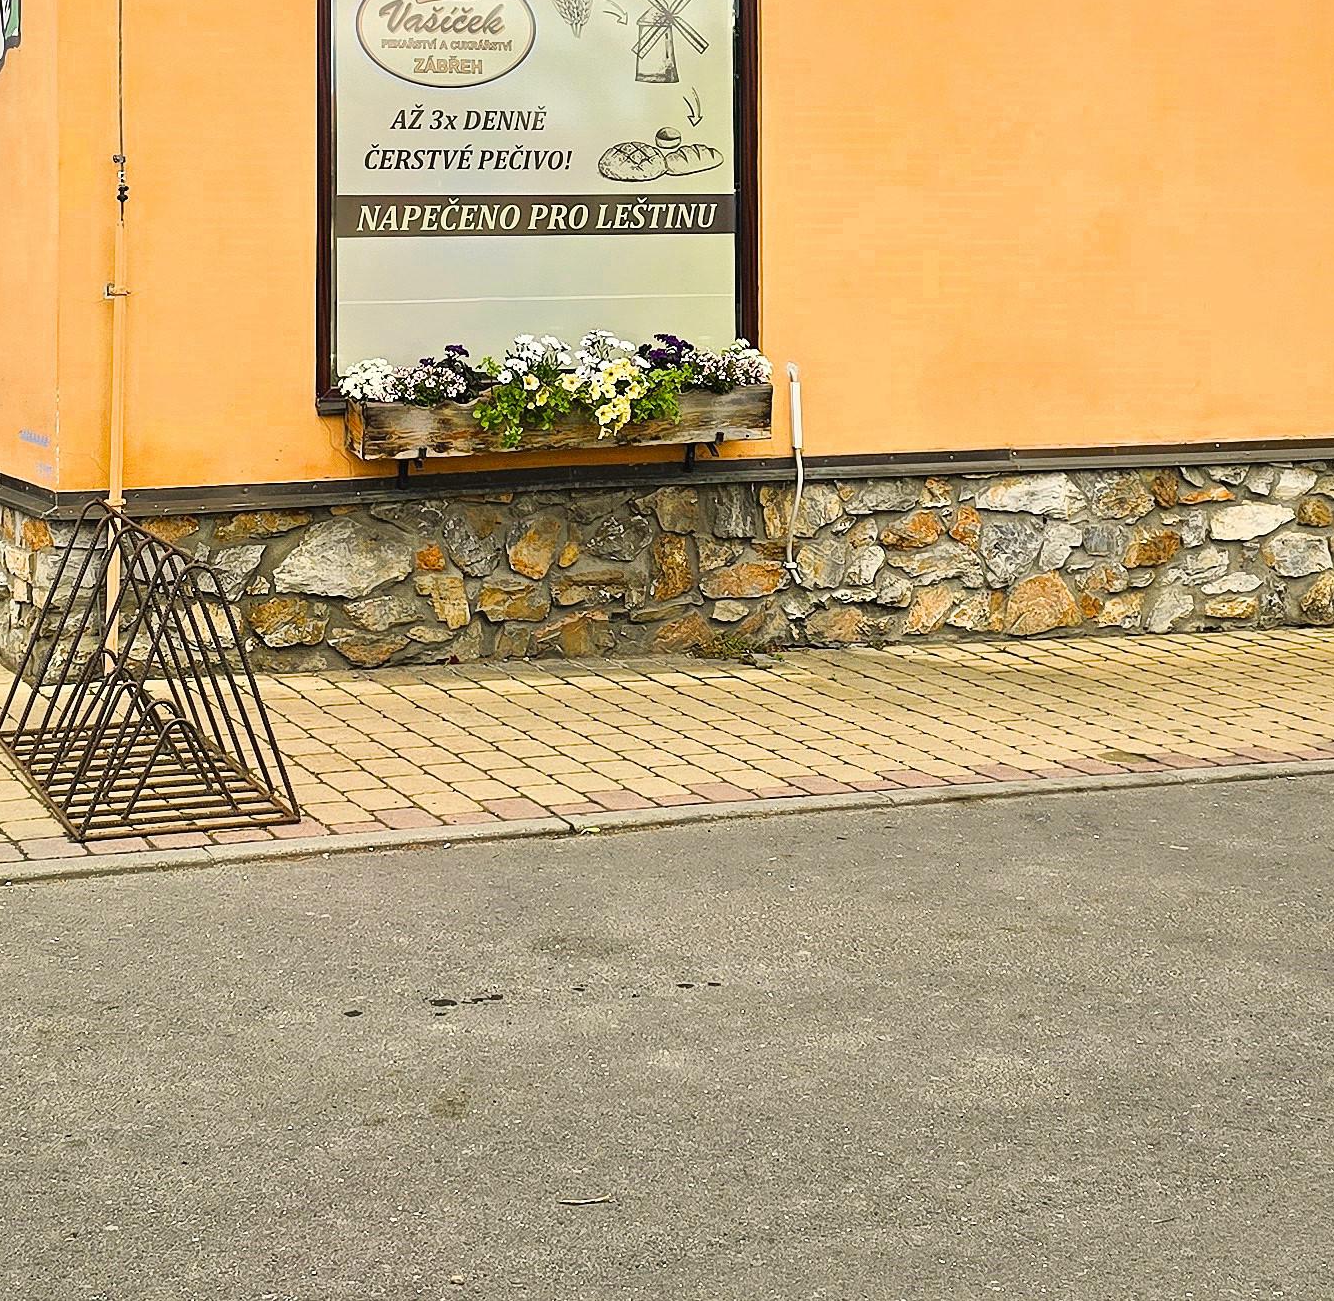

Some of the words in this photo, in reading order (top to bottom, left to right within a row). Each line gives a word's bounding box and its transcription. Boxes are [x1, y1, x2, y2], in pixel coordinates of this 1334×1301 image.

[381, 38, 437, 50] PEKAŘSTVÍ
[440, 40, 448, 50] A
[451, 39, 512, 52] CUKRÁŘSTVÍ
[414, 55, 483, 75] ZÁBŘEH
[390, 104, 424, 130] AŽ
[429, 110, 458, 130] 3x
[463, 106, 547, 130] DENNĚ
[364, 144, 473, 170] ČERSTVÉ
[478, 145, 572, 170] PEČIVO!
[356, 198, 521, 231] NAPEČENO
[528, 204, 589, 231] PRO
[596, 197, 718, 230] LEŠTINU
